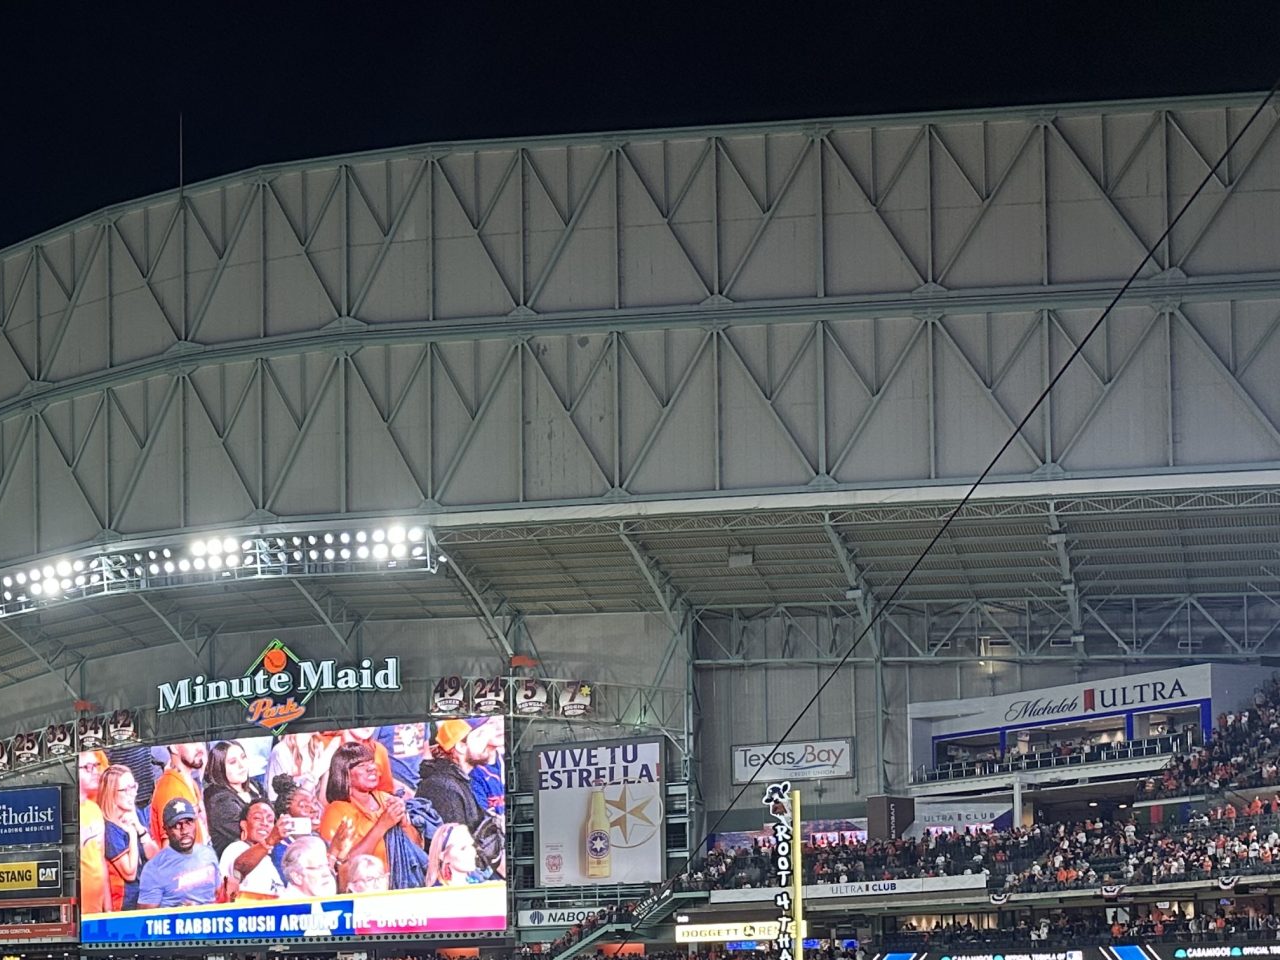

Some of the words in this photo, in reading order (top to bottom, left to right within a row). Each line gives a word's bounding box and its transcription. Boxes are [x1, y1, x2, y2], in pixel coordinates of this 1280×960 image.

[157, 671, 290, 713] Minute
[298, 656, 401, 692] Maid
[434, 676, 461, 698] 49
[474, 676, 502, 699] 24
[524, 679, 537, 700] 5
[567, 680, 581, 703] 7
[1004, 695, 1079, 723] Michelob
[1099, 678, 1187, 709] ULTRA
[109, 709, 131, 728] 42
[246, 697, 305, 727] Park
[47, 724, 67, 743] 33
[78, 717, 100, 735] 34
[15, 734, 36, 751] 25
[610, 743, 640, 765] TU
[739, 747, 795, 768] Texas
[803, 745, 844, 770] Bay
[924, 813, 954, 823] ULTRA
[965, 812, 996, 821] CLUB
[773, 823, 792, 887] ROOT
[39, 867, 58, 881] CAT
[831, 884, 864, 895] ULTRA
[871, 883, 897, 892] CLUB
[146, 920, 170, 935] THE
[174, 917, 234, 934] RABBITS
[238, 915, 276, 932] RUSH
[345, 911, 371, 929] THE
[548, 910, 606, 924] NABOR
